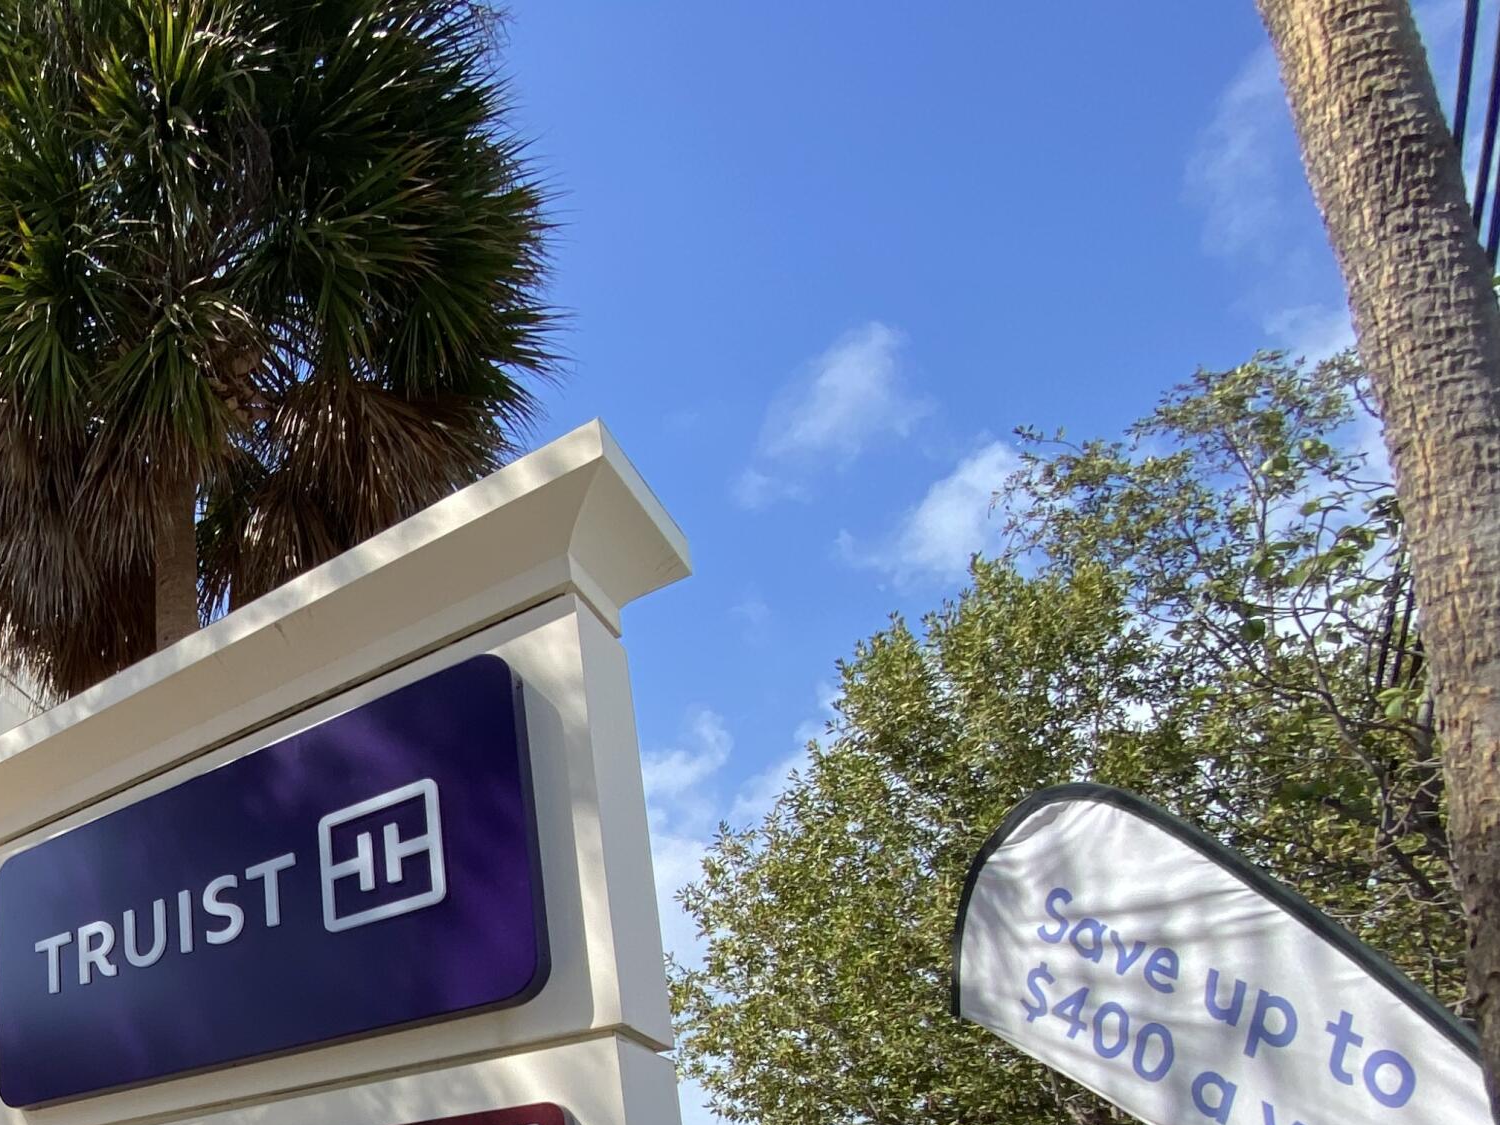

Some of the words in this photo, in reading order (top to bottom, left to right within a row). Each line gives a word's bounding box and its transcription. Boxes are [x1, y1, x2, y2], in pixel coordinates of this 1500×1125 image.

[34, 852, 296, 994] TRUIST
[1037, 888, 1180, 995] Save
[1204, 968, 1298, 1058] up
[1325, 1011, 1416, 1109] to
[1020, 962, 1174, 1082] $400
[1191, 1071, 1237, 1125] a
